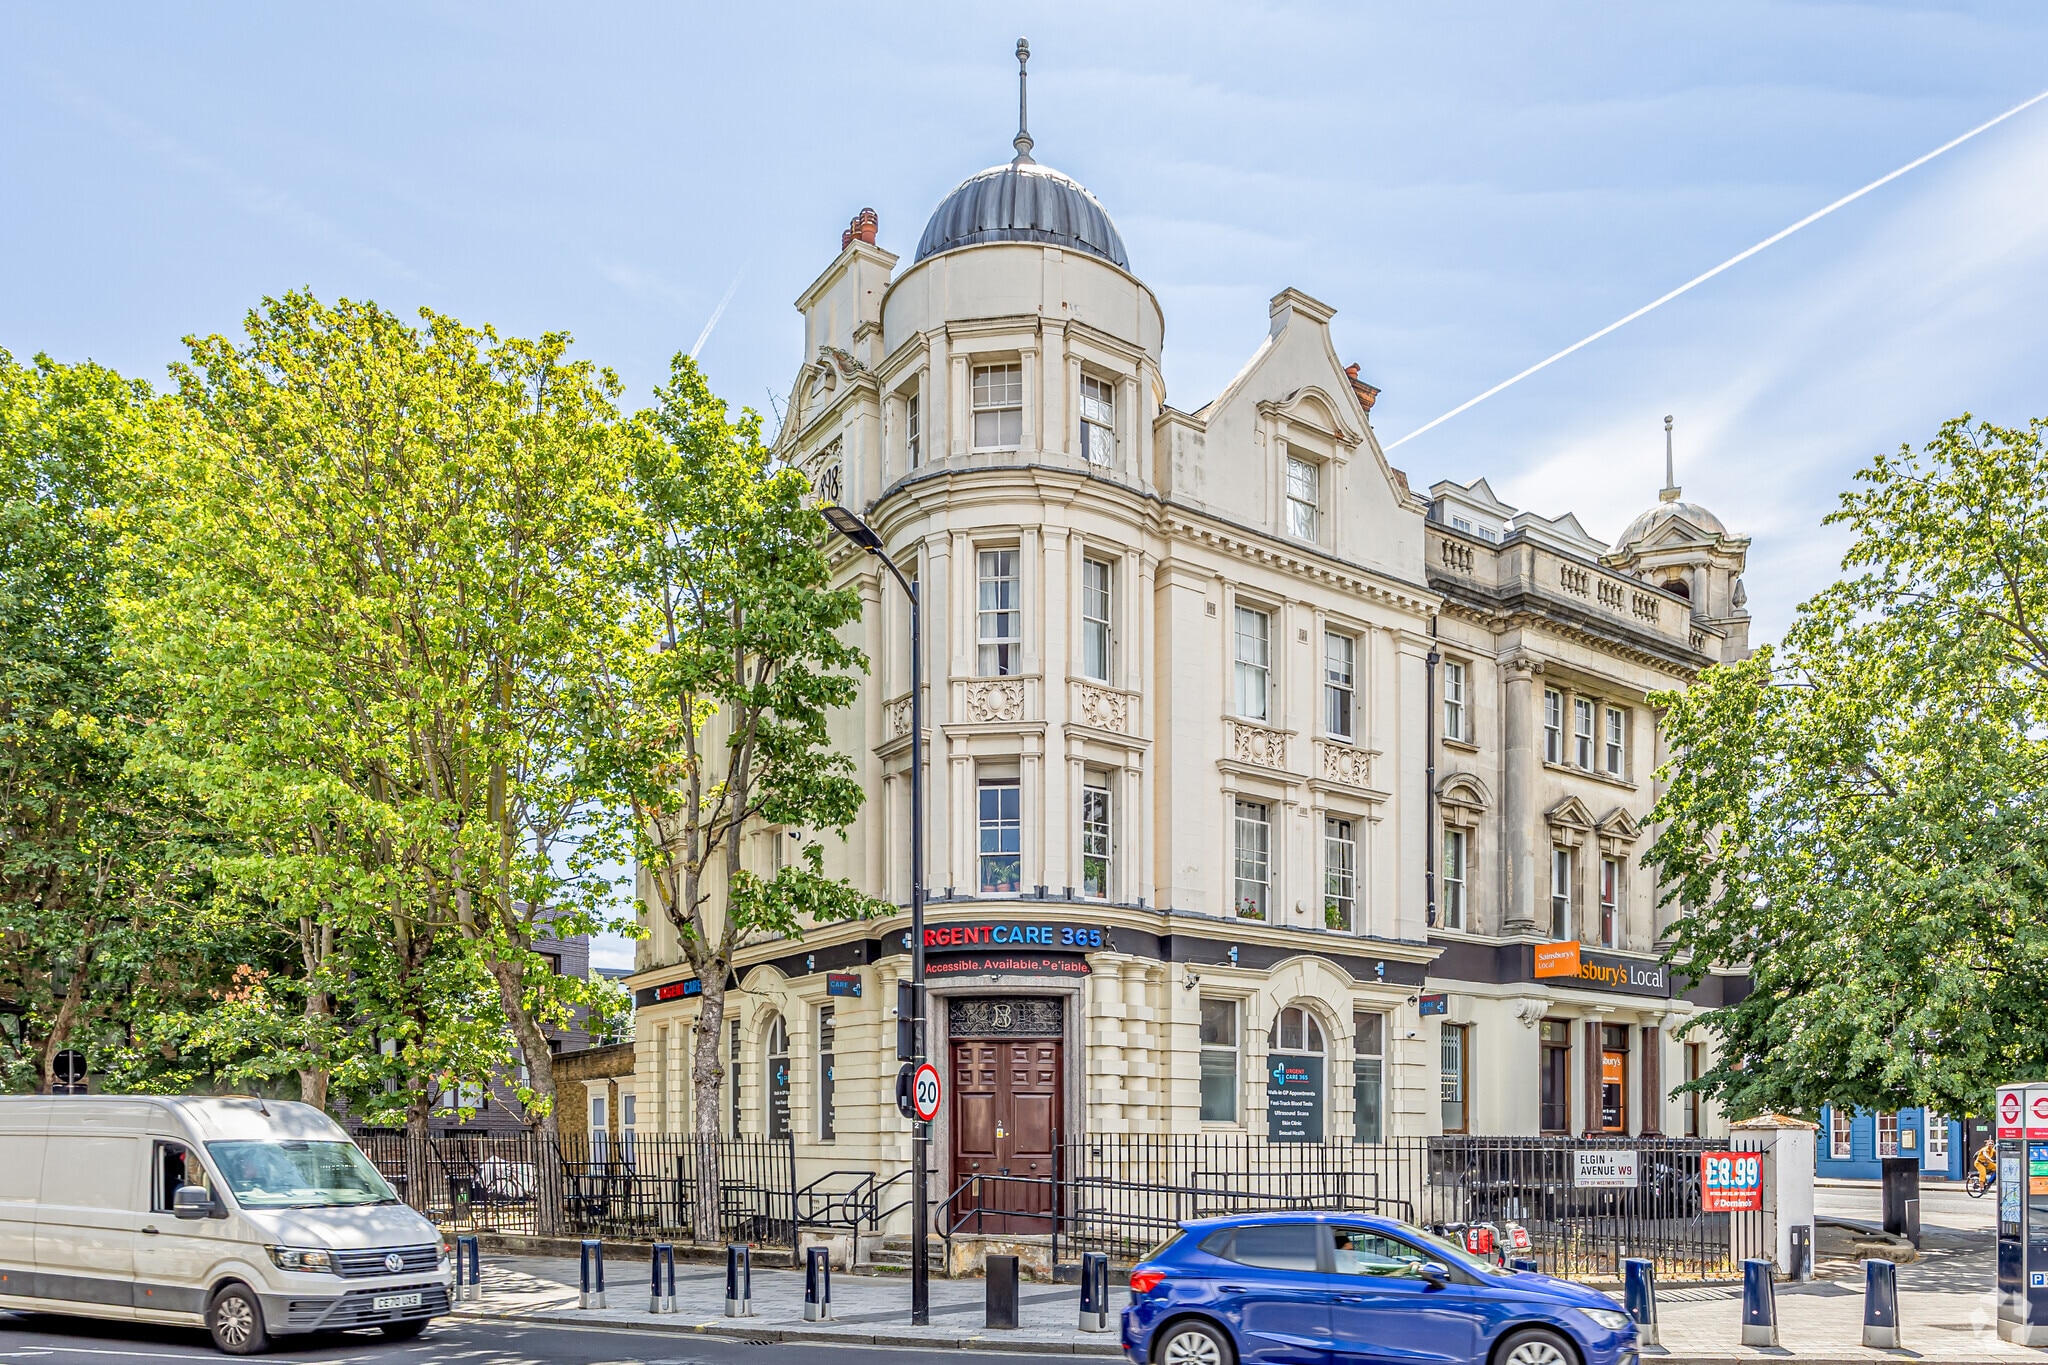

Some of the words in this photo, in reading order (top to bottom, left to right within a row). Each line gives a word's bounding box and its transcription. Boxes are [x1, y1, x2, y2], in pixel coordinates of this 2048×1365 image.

[924, 926, 1053, 947] RGENTCARE
[1061, 927, 1102, 947] 365
[1538, 951, 1574, 961] Sainsbury's
[925, 959, 982, 973] Accessible.
[984, 959, 1042, 970] Available.
[1538, 961, 1554, 969] Local
[1570, 960, 1628, 987] nsbury's
[1630, 965, 1663, 988] Local
[918, 1081, 937, 1104] 20
[1580, 1155, 1605, 1164] ELGIN
[1581, 1166, 1615, 1175] AVENUE
[1618, 1166, 1632, 1175] W9
[1706, 1158, 1759, 1187] £8.99
[1720, 1199, 1752, 1207] Domino's
[2034, 1275, 2042, 1284] P
